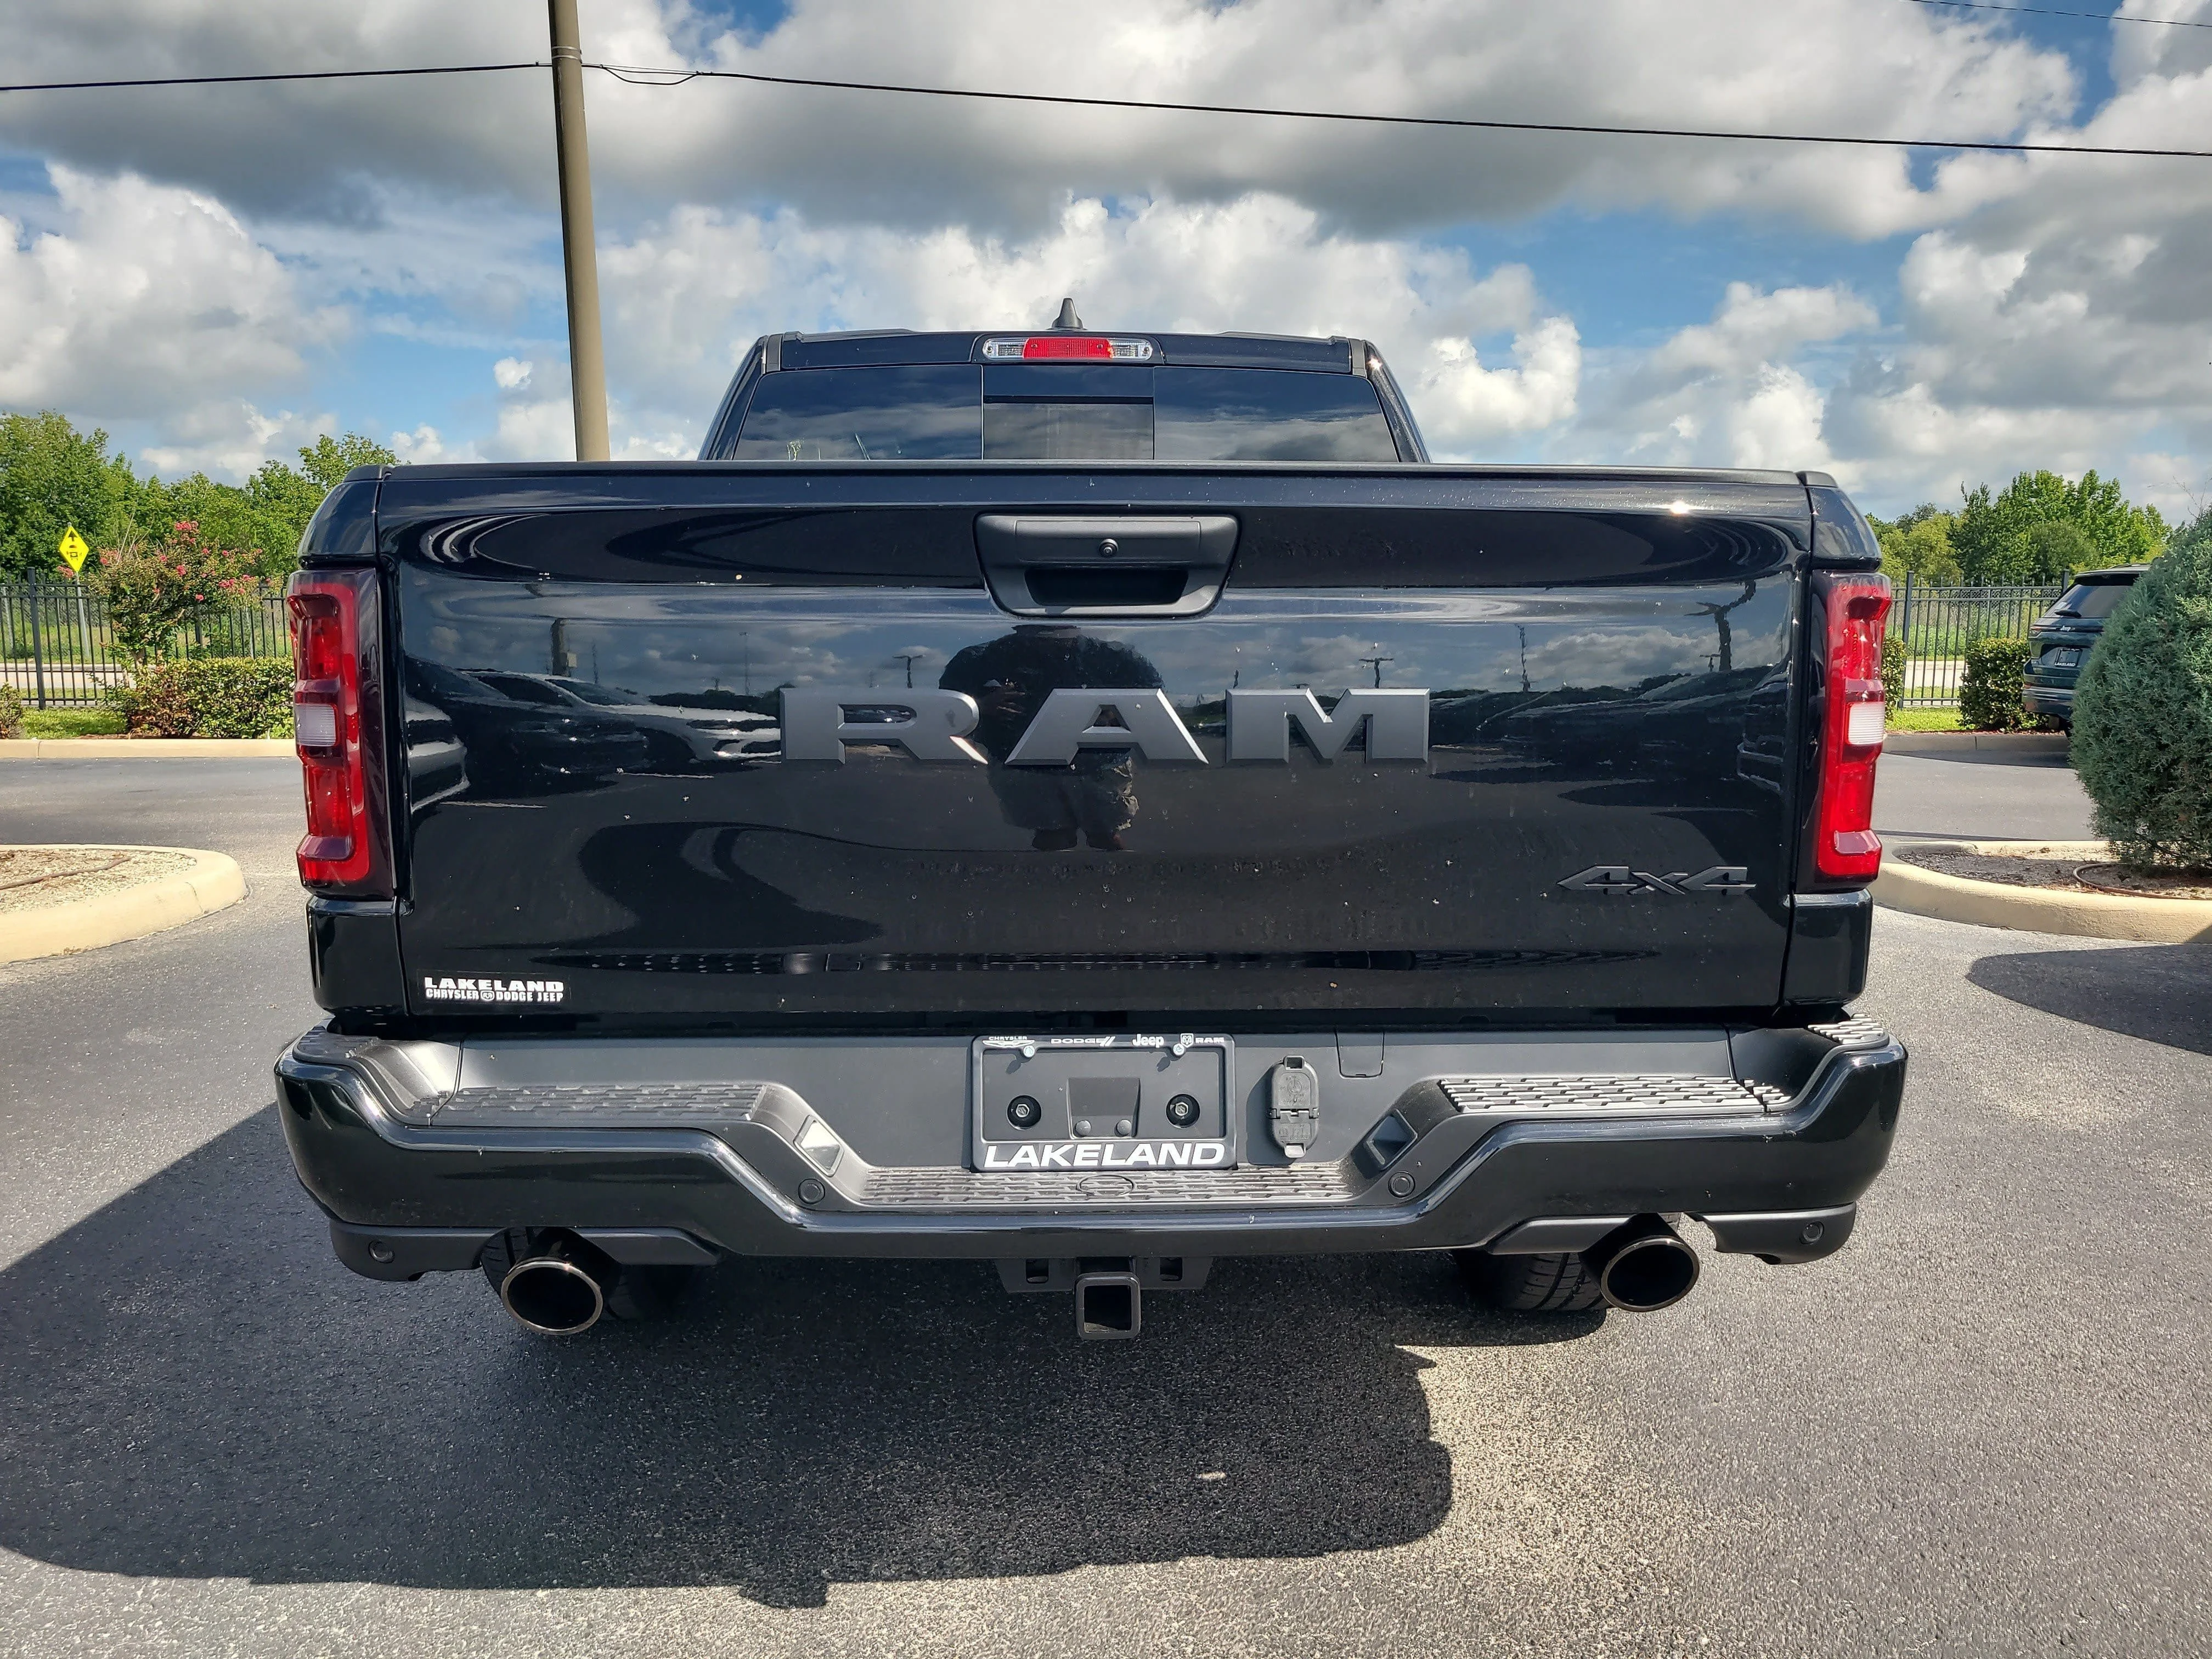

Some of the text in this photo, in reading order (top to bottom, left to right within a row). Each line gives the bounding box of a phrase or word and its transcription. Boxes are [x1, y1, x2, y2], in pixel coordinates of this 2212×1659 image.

[780, 688, 1430, 765] RAM
[425, 977, 564, 992] LAKELAND
[426, 988, 564, 1002] CHRYSLER DODGE JEEP
[1132, 1034, 1165, 1048] Jeep
[984, 1143, 1226, 1168] LAKELAND
